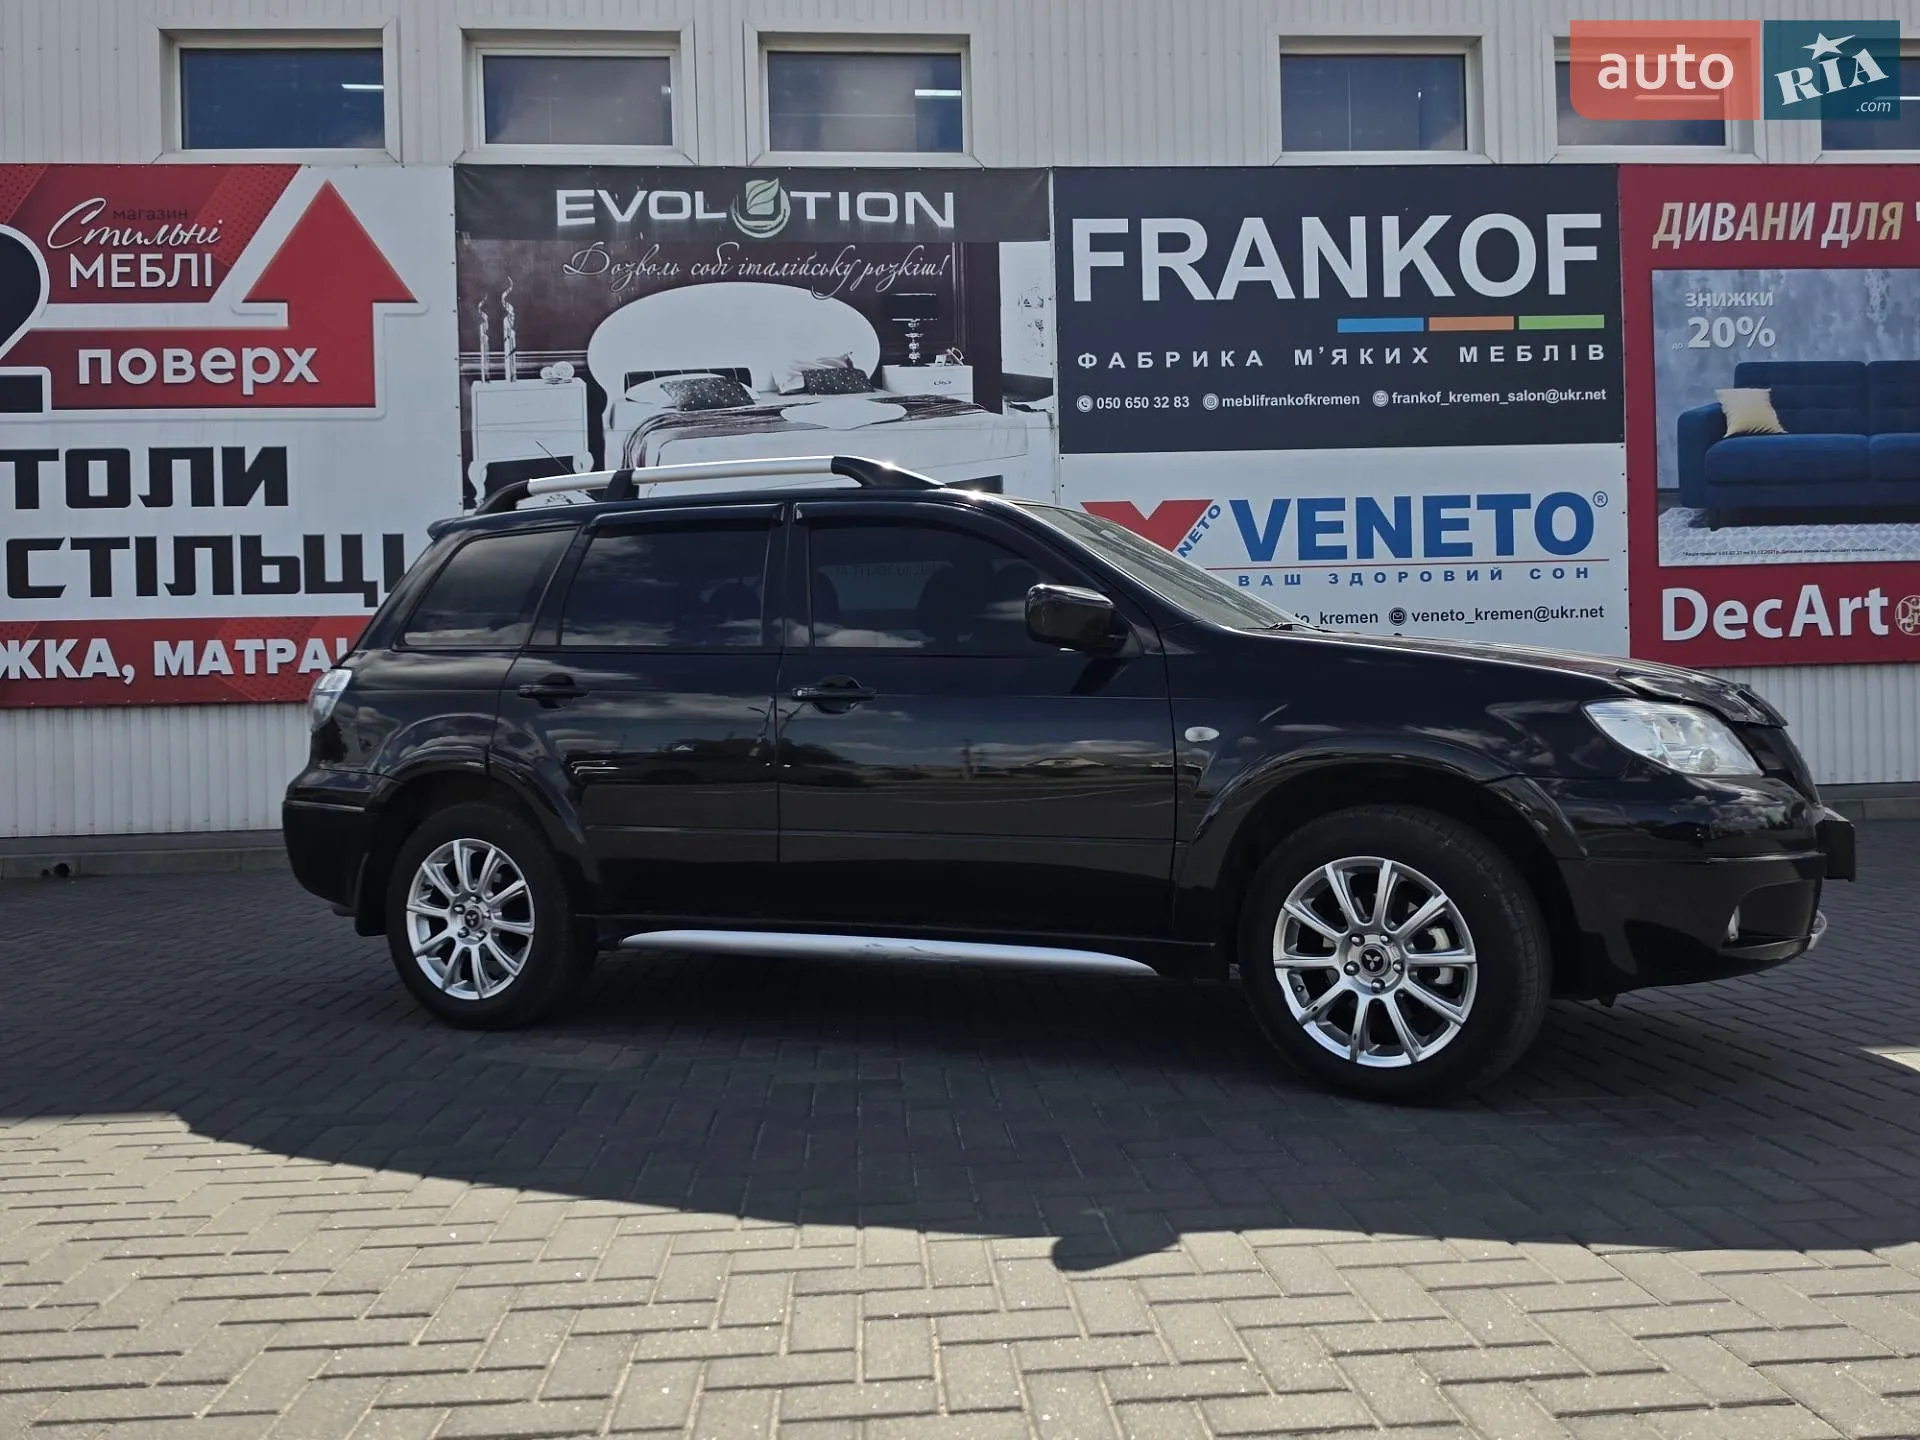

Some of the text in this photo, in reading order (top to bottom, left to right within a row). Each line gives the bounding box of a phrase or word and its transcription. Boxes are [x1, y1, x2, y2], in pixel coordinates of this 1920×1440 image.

[47, 197, 223, 249] Стильні
[113, 208, 188, 220] магазин
[1652, 201, 1815, 249] ДИВАНИ
[1820, 201, 1904, 248] ДЛЯ
[69, 253, 213, 288] МЕБЛІ
[563, 241, 951, 300] Дозволь собі італійську розкіш!
[1071, 212, 1602, 302] FRANKOF
[1077, 344, 1605, 369] ФАБРИКА М'ЯКИХ МЕБЛІВ
[1687, 315, 1777, 349] 20%
[77, 347, 320, 396] поверх
[1096, 388, 1607, 410] 050 650 32 83 meblifrankofkremen frankof_kremen_salon@ukr.net
[0, 446, 288, 510] ТОЛИ
[1176, 504, 1221, 558] NETO
[1229, 491, 1594, 562] VENETO
[6, 533, 405, 608] СТІЛЬЦІ
[1238, 567, 1589, 587] ВАШ ЗДОРОВИЙ СОН
[1295, 605, 1605, 628] o_kremen veneto_kremen@ukr.net
[1662, 584, 1889, 641] DecArt
